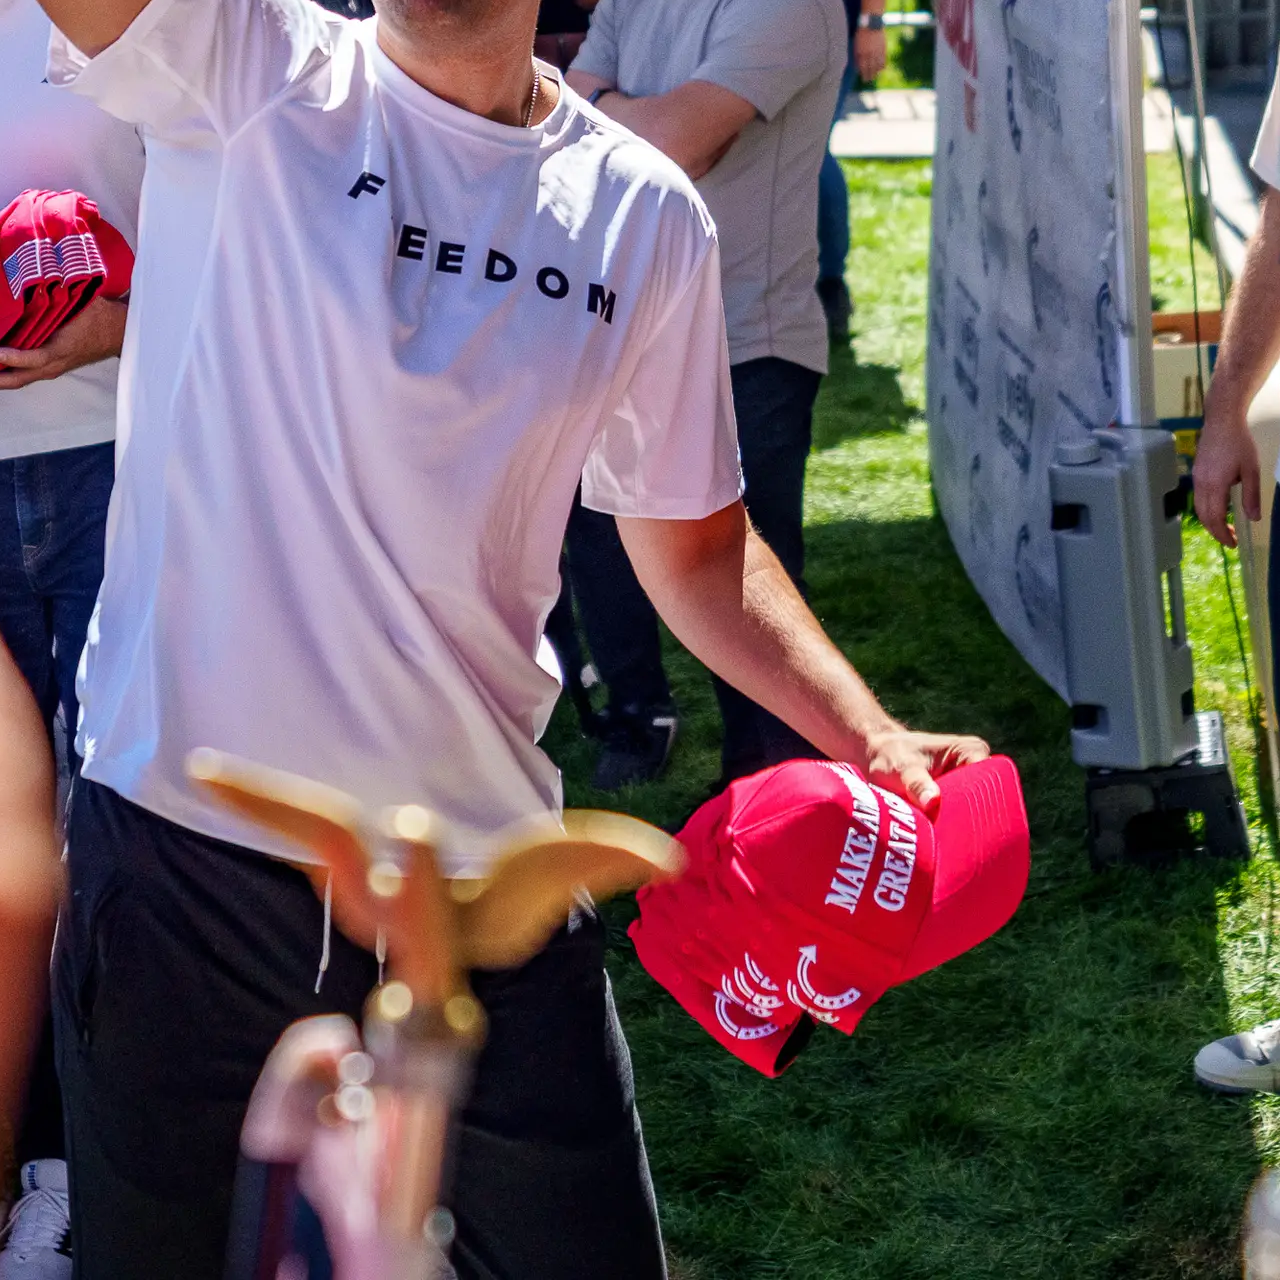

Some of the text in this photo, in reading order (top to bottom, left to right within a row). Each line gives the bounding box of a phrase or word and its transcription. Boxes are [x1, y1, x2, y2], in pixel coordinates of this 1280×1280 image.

[347, 170, 617, 325] FEEDOM
[824, 826, 878, 915] MAKE
[873, 820, 918, 912] GREAT
